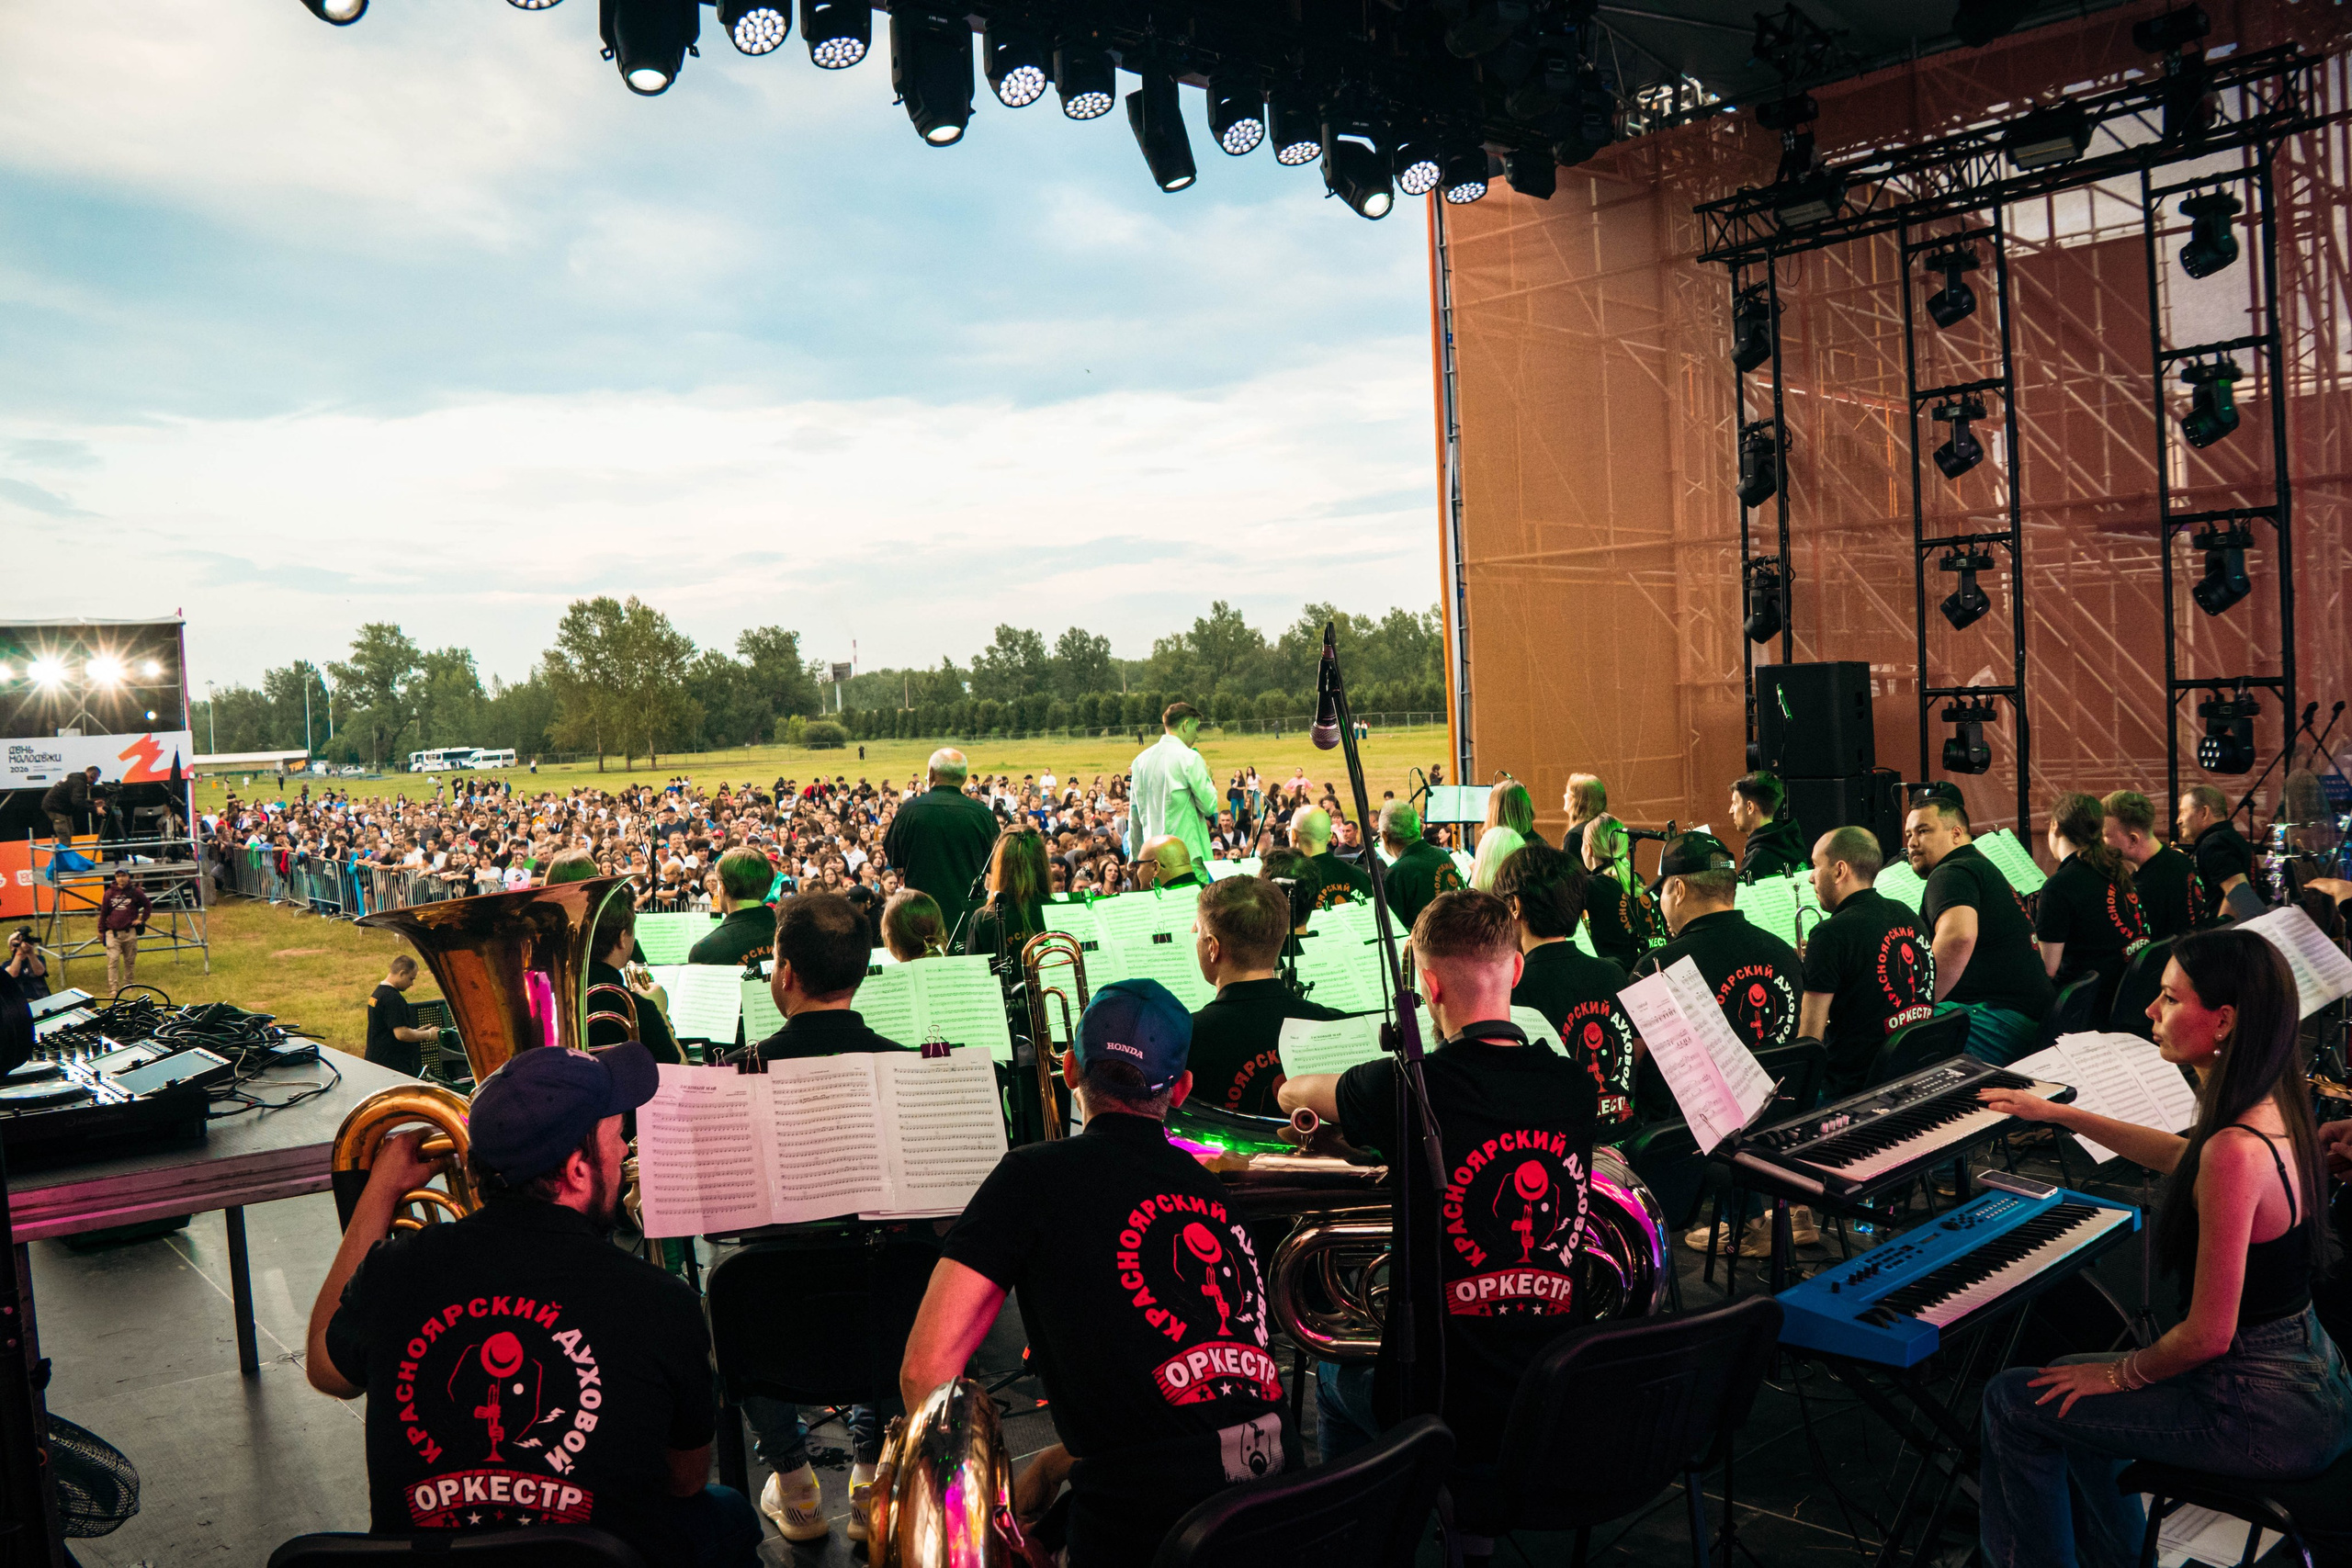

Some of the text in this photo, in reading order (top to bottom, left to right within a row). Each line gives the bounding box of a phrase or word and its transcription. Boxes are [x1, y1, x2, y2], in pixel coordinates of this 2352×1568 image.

[1316, 883, 1351, 908] ОЯРСКИЙ
[1877, 926, 1915, 1008] КРАСНОЯРСКИЙ
[1716, 964, 1795, 1044] ОЯРСКИЙ ДУХОВОЙ
[1888, 1007, 1932, 1029] ОРКЕСТР
[1106, 1042, 1144, 1059] HONDA
[1611, 1011, 1634, 1092] ДУХОВОЙ
[1442, 1130, 1591, 1269] КРАСНОЯРСКИЙ ДУХОВОЙ
[1116, 1193, 1269, 1348] КРАСНОЯРСКИЙ ДУХОВОЙ
[1455, 1273, 1571, 1303] ОРКЕСТР
[396, 1295, 602, 1475] КРАСНОЯРСКИЙ ДУХОВОЙ
[1165, 1347, 1276, 1389] ОРКЕСТР
[414, 1473, 583, 1512] ОРКЕСТР
